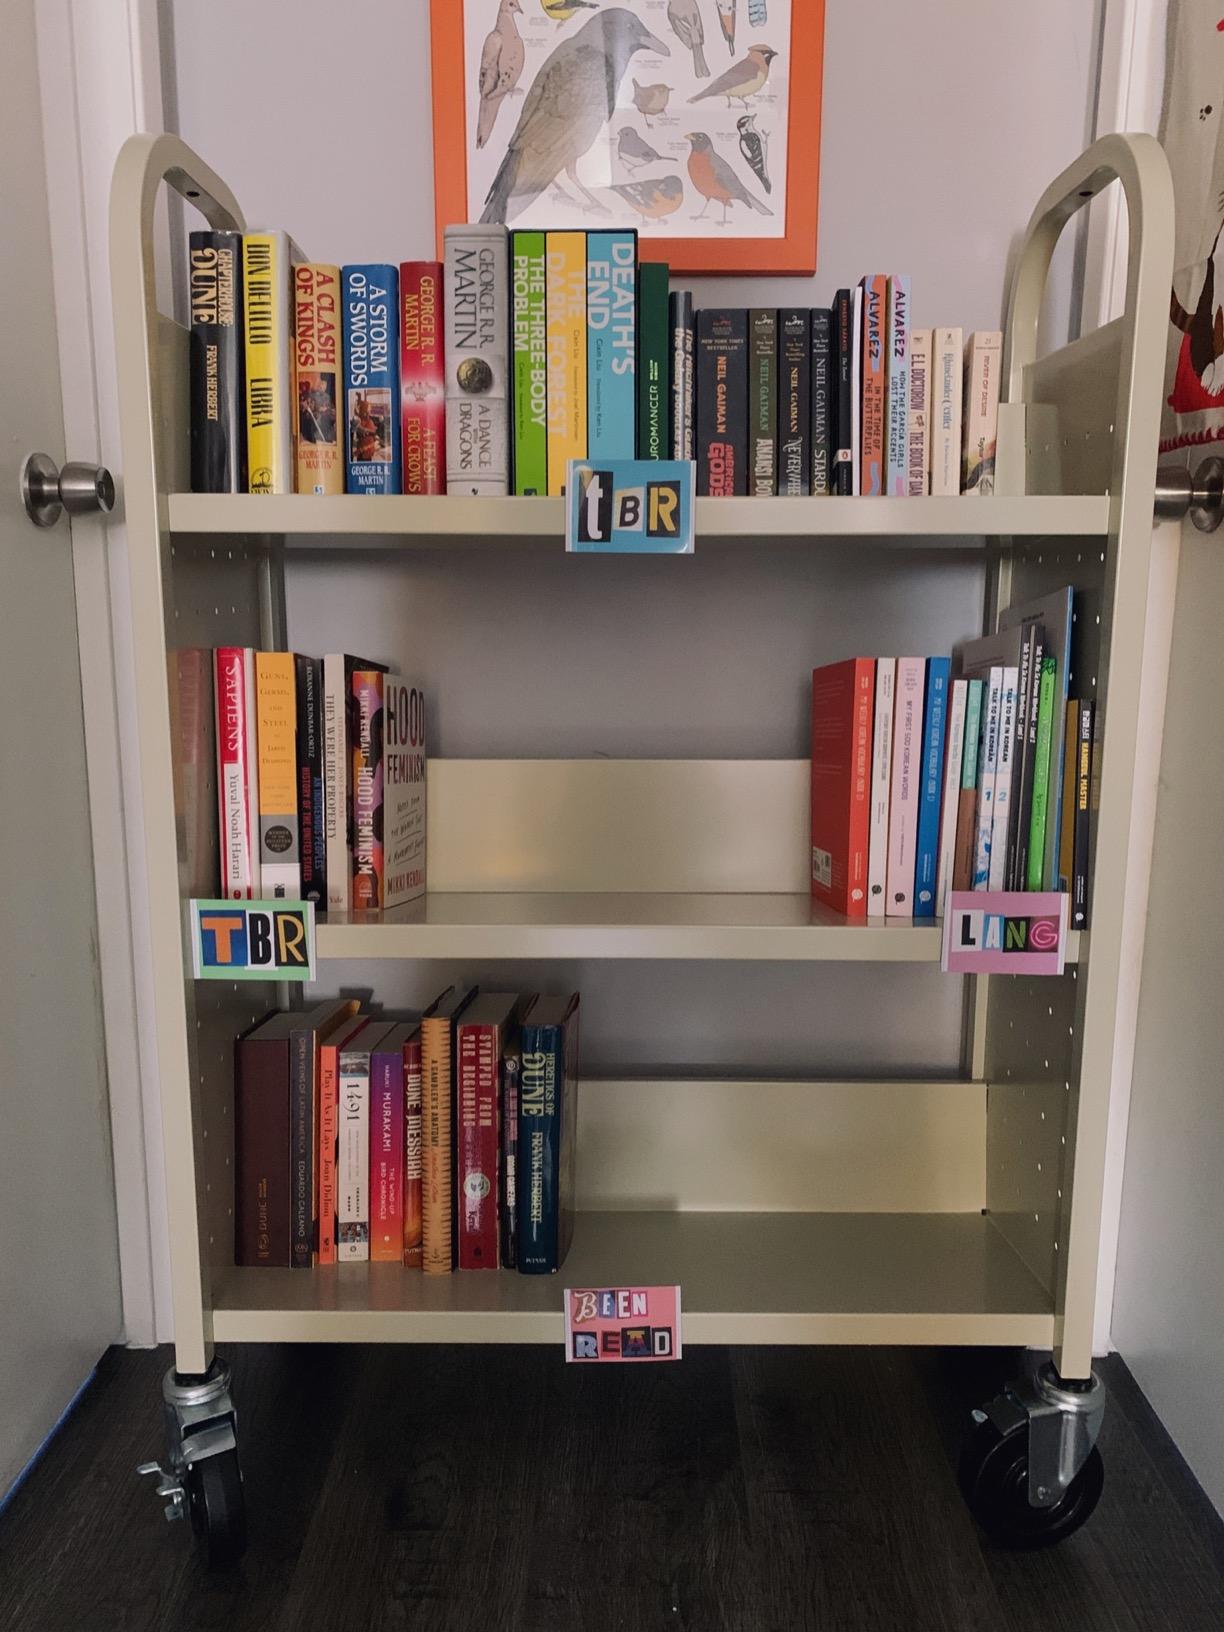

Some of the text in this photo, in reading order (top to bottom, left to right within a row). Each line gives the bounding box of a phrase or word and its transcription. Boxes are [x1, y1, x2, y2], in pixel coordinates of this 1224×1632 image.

[190, 247, 219, 325] DUNE
[246, 243, 273, 345] DON DELILLO
[454, 248, 478, 349] MARTIN
[478, 248, 495, 313] GEORGE
[513, 255, 529, 351] PROBLEM
[567, 270, 586, 318] THE
[587, 261, 610, 331] END
[296, 267, 316, 367] OF KINGS
[316, 271, 337, 365] A CLASH
[349, 273, 368, 386] OF SWORDS
[370, 285, 388, 374] A STORM
[405, 294, 420, 350] MARTIN
[419, 276, 436, 367] GEORGE R. R.
[611, 242, 635, 375] DEATH'S
[868, 291, 880, 360] ALVAREZ
[894, 290, 905, 358] ALVAREZ
[528, 255, 547, 427] THE THREE-BODY
[547, 252, 566, 437] DARK FOREST
[206, 345, 218, 421] FRANK HERBERT
[716, 356, 727, 433] NEIL GAIMAN
[759, 358, 769, 384] NEIL
[790, 367, 799, 390] NEIL
[816, 358, 826, 389] NEIL
[911, 368, 925, 412] DOCTOROW
[250, 377, 273, 429] LIBRA
[759, 386, 769, 431] GAIMAN
[790, 392, 799, 433] GAIMAN
[815, 389, 826, 443] GAIMAN
[864, 377, 873, 456] THE BUTTERFLIES
[873, 385, 881, 449] IN THE TIME OF
[890, 399, 898, 425] THEIR
[407, 418, 422, 492] FOR CROWS
[423, 427, 436, 481] A FEAST
[459, 402, 473, 470] DRAGONS
[478, 404, 492, 467] A DANCE
[755, 437, 774, 478] ANANSI
[889, 426, 898, 463] ACCENTS
[909, 431, 924, 480] THE BOOK OF
[305, 460, 331, 470] MARTIN
[351, 465, 377, 476] GEORGE
[358, 475, 384, 485] MARTIN
[783, 436, 803, 496] NEVERWHE
[814, 448, 828, 496] STARDU
[225, 665, 242, 752] SAPIENS
[306, 665, 316, 759] ROXANNE DUNBAR-ORTIZ
[386, 685, 425, 747] HOOD
[990, 705, 998, 715] TO
[990, 715, 997, 726] ME
[991, 687, 999, 705] TALK
[1005, 688, 1014, 705] TALK
[1005, 705, 1013, 715] TO
[1005, 715, 1013, 726] ME
[359, 689, 370, 759] MIKKI KENDALL
[987, 734, 997, 763] KOREAN
[1003, 734, 1011, 763] KOREAN
[326, 694, 337, 841] THEY WERE HER PROPERTY
[357, 766, 373, 806] HOOD
[386, 753, 425, 785] FEMINISM
[1079, 779, 1088, 810] MASTER
[985, 791, 993, 801] 1
[998, 792, 1007, 802] 2
[229, 773, 242, 881] Yuval Noah Harari
[357, 810, 373, 875] FEMINISM
[201, 912, 305, 965] TBR
[960, 914, 1058, 949] LANG
[322, 1069, 334, 1089] Play
[324, 1091, 333, 1100] It
[343, 1083, 362, 1121] 1491
[406, 1073, 421, 1108] DUNE
[463, 1034, 476, 1127] THE BEGINNING
[479, 1034, 492, 1127] STAMPED FROM
[521, 1051, 547, 1118] DUNE
[545, 1052, 556, 1116] HERETICS OF
[323, 1104, 333, 1116] As
[382, 1091, 392, 1152] MURAKAMI
[430, 1111, 440, 1148] ANATOMY
[321, 1129, 333, 1152] Lays
[406, 1113, 422, 1180] MESSIAH
[297, 1160, 306, 1199] EDUARDO
[323, 1158, 333, 1218] Joan Didion
[530, 1131, 544, 1223] FRANK HERBERT
[574, 1291, 647, 1322] BEEN
[575, 1329, 670, 1358] READ
